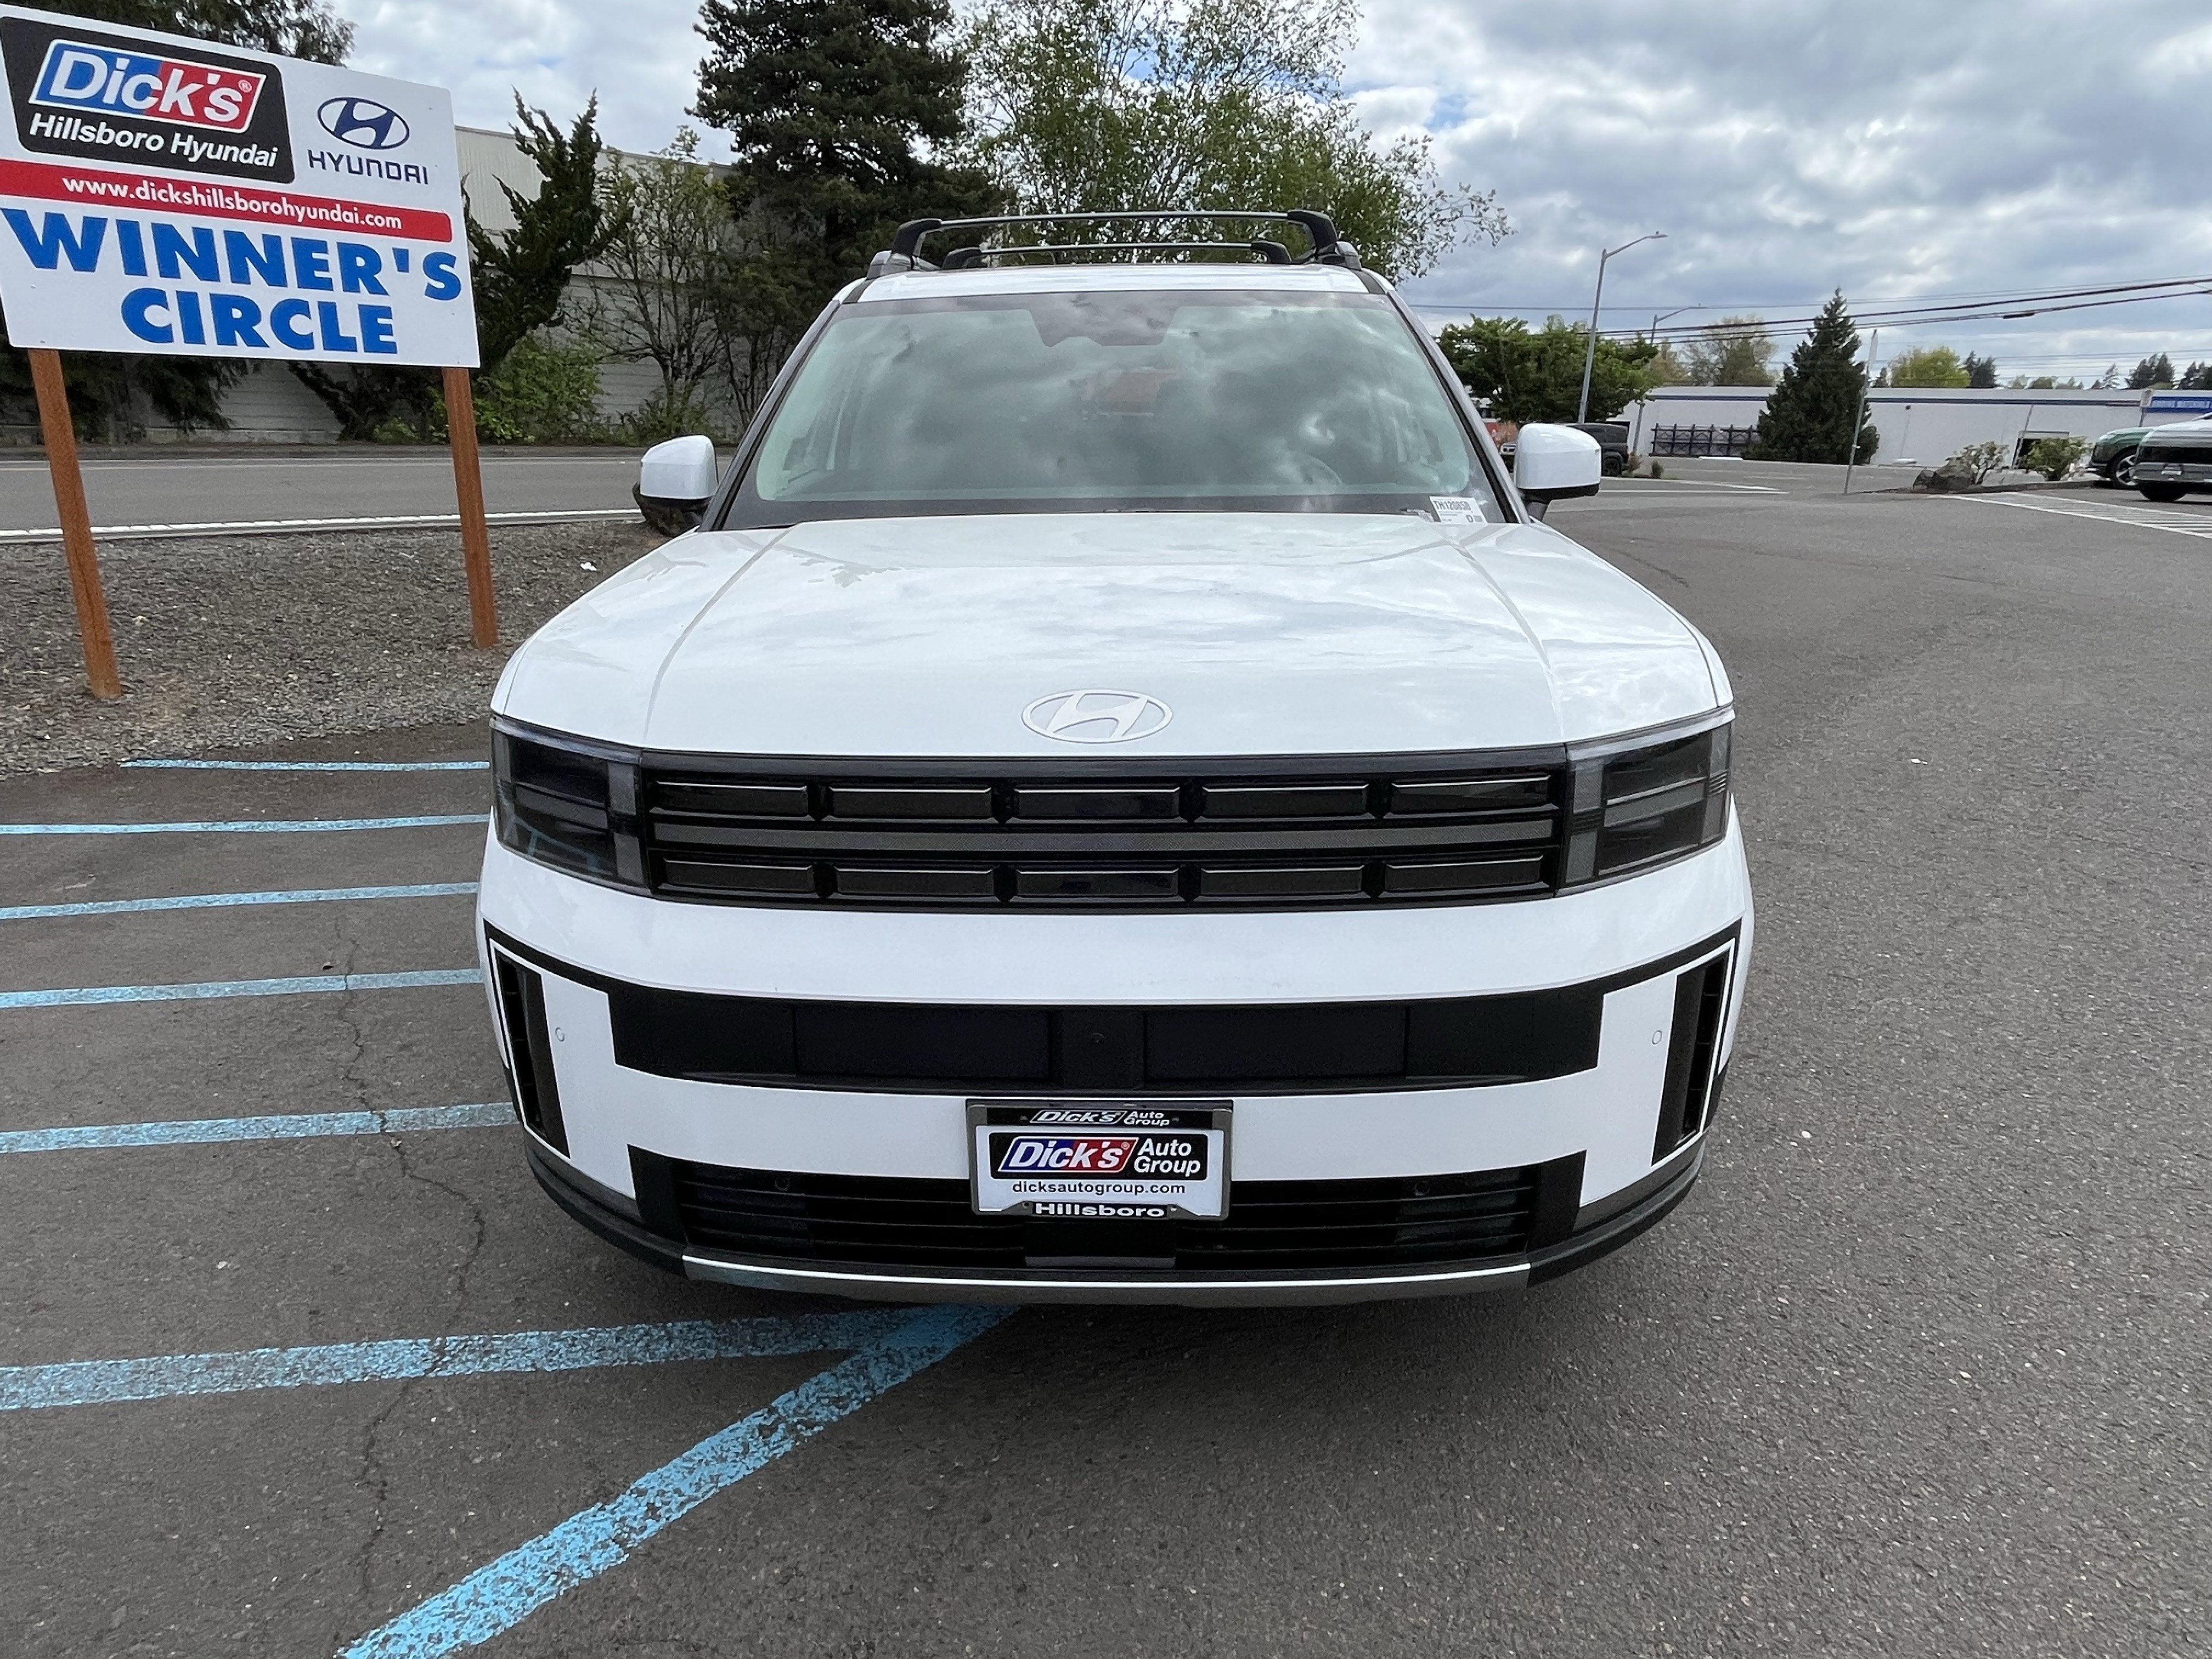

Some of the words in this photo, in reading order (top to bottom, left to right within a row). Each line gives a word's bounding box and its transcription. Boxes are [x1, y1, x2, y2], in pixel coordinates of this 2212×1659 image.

[49, 52, 243, 122] Dick's
[30, 114, 163, 151] Hillsboro
[171, 132, 278, 167] Hyundai
[308, 150, 428, 184] HYUNDAI
[63, 176, 402, 229] www.dickshillsborohyundai.com
[1, 208, 462, 301] WINNER'S
[121, 288, 397, 354] CIRCLE
[1038, 1111, 1116, 1122] Dick's
[1124, 1118, 1170, 1126] Group
[1009, 1141, 1122, 1169] Dick's
[1138, 1138, 1192, 1156] Auto
[1134, 1156, 1200, 1176] Group
[1013, 1181, 1185, 1195] dicksautogroup.com
[1036, 1203, 1164, 1217] Hillsboro
